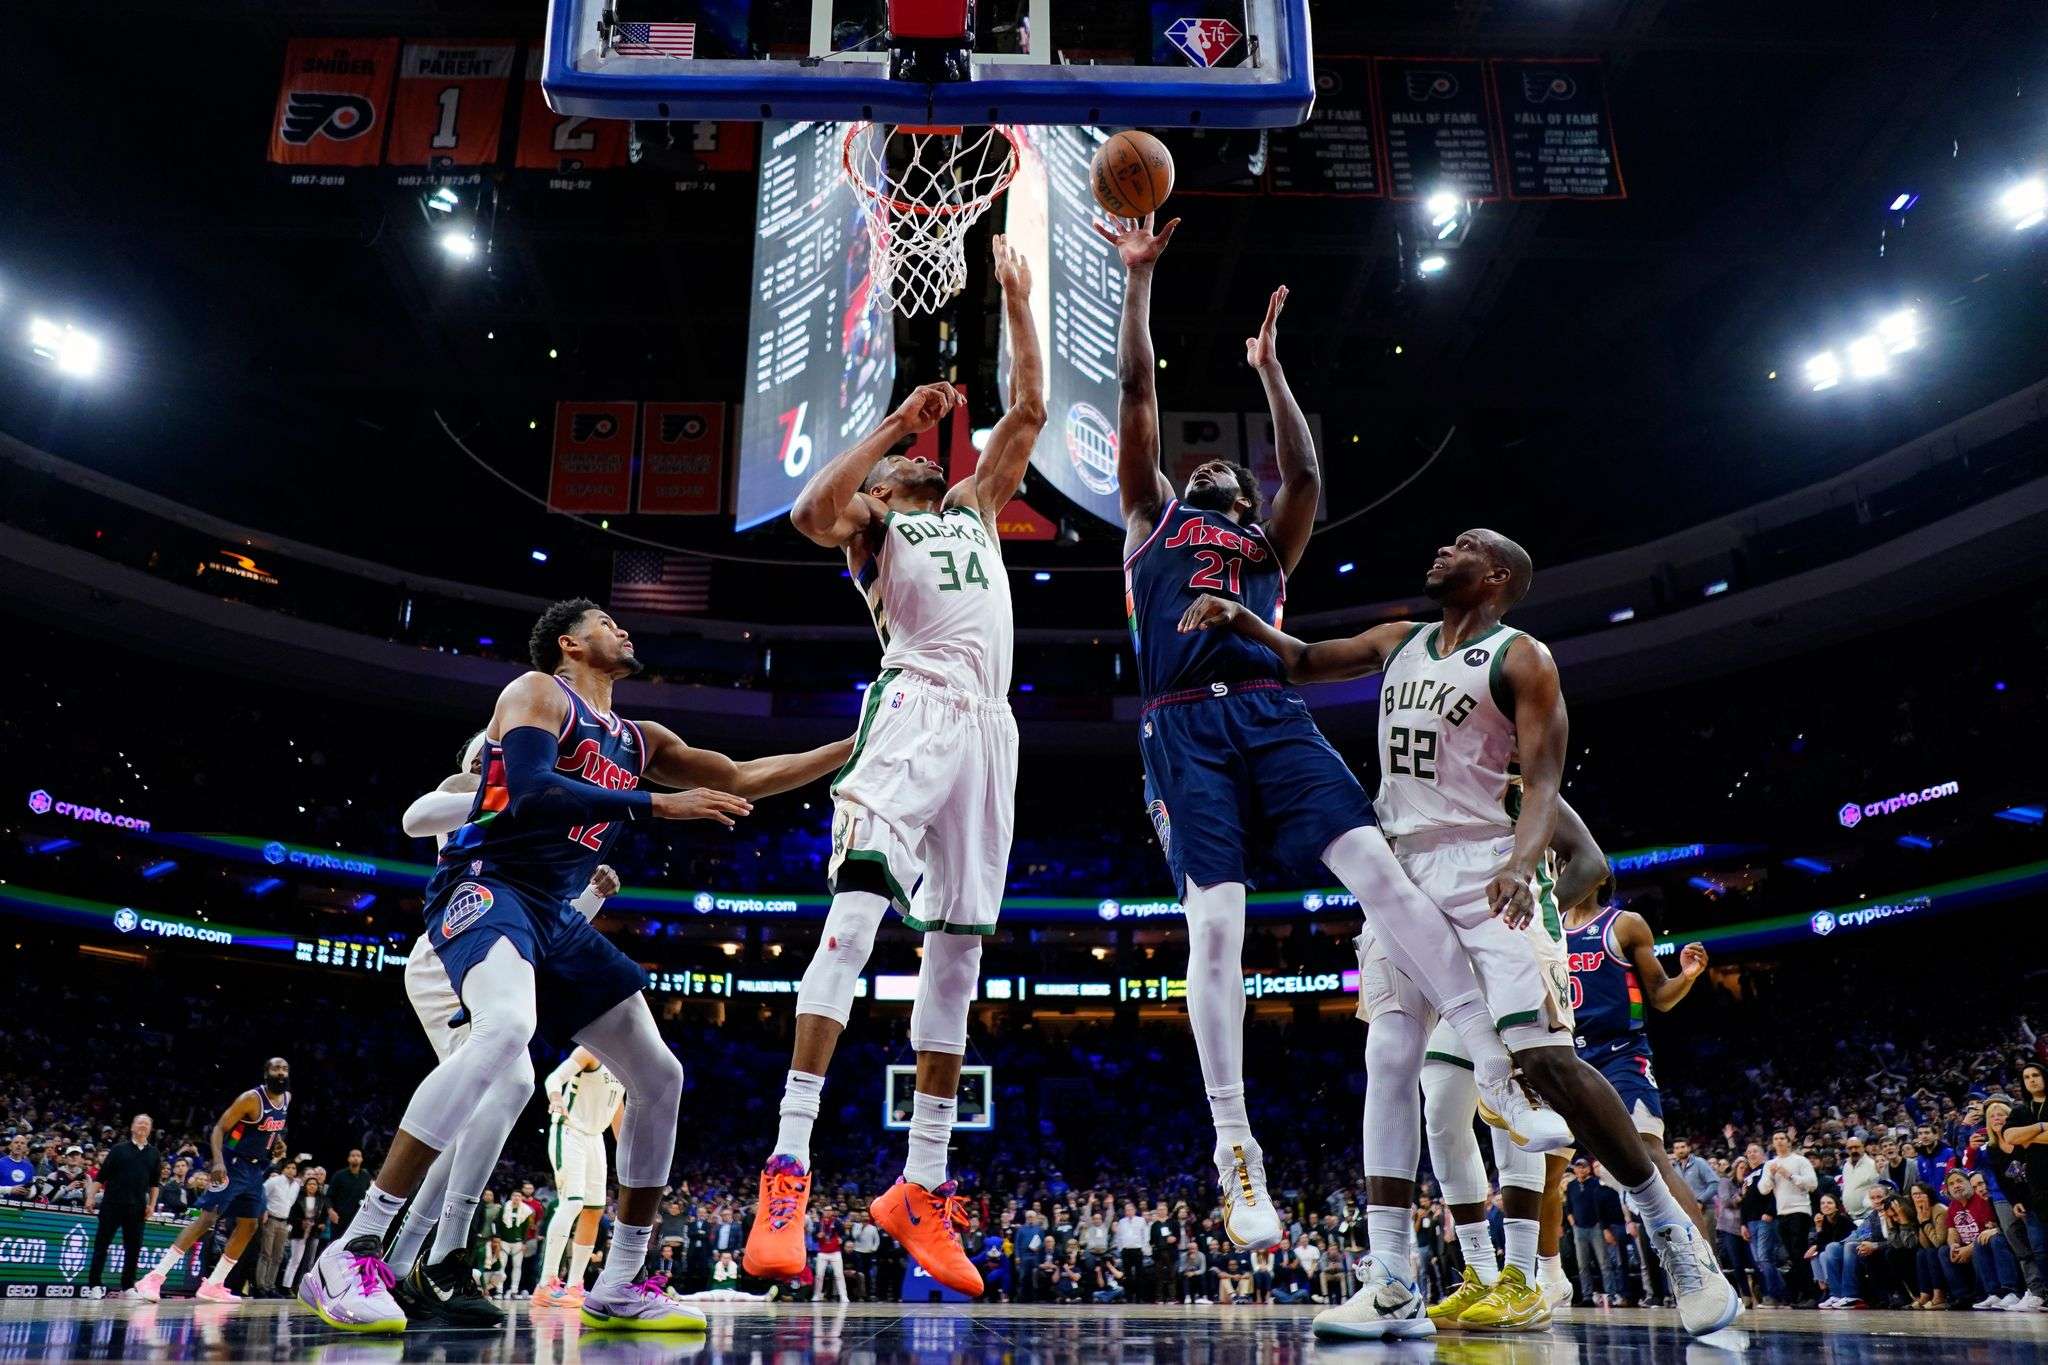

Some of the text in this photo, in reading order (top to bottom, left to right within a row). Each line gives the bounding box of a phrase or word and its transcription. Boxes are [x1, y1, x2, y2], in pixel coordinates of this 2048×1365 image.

[1210, 27, 1224, 42] 75
[419, 60, 493, 75] PARENT
[431, 87, 461, 149] 1
[1327, 110, 1363, 122] FAME
[1424, 113, 1443, 125] OF
[1443, 113, 1479, 125] FAME
[1547, 113, 1563, 125] OF
[1565, 112, 1601, 126] FAME
[896, 520, 987, 549] BUCKS
[929, 550, 990, 591] 34
[1188, 549, 1243, 595] 21
[1384, 679, 1479, 728] BUCKS
[1389, 726, 1438, 780] 22
[1863, 779, 1960, 819] crypto.com
[54, 800, 152, 833] crypto.com
[289, 849, 377, 877] crypto.com
[1616, 842, 1706, 872] crypto.com
[715, 897, 797, 914] crypto.com
[1120, 901, 1187, 918] crypto.co
[1838, 895, 1935, 927] crypto.com
[140, 917, 233, 945] crypto.com
[1262, 974, 1340, 993] 2CELLOS
[6, 1284, 38, 1298] GEICO
[45, 1284, 75, 1298] GEICO
